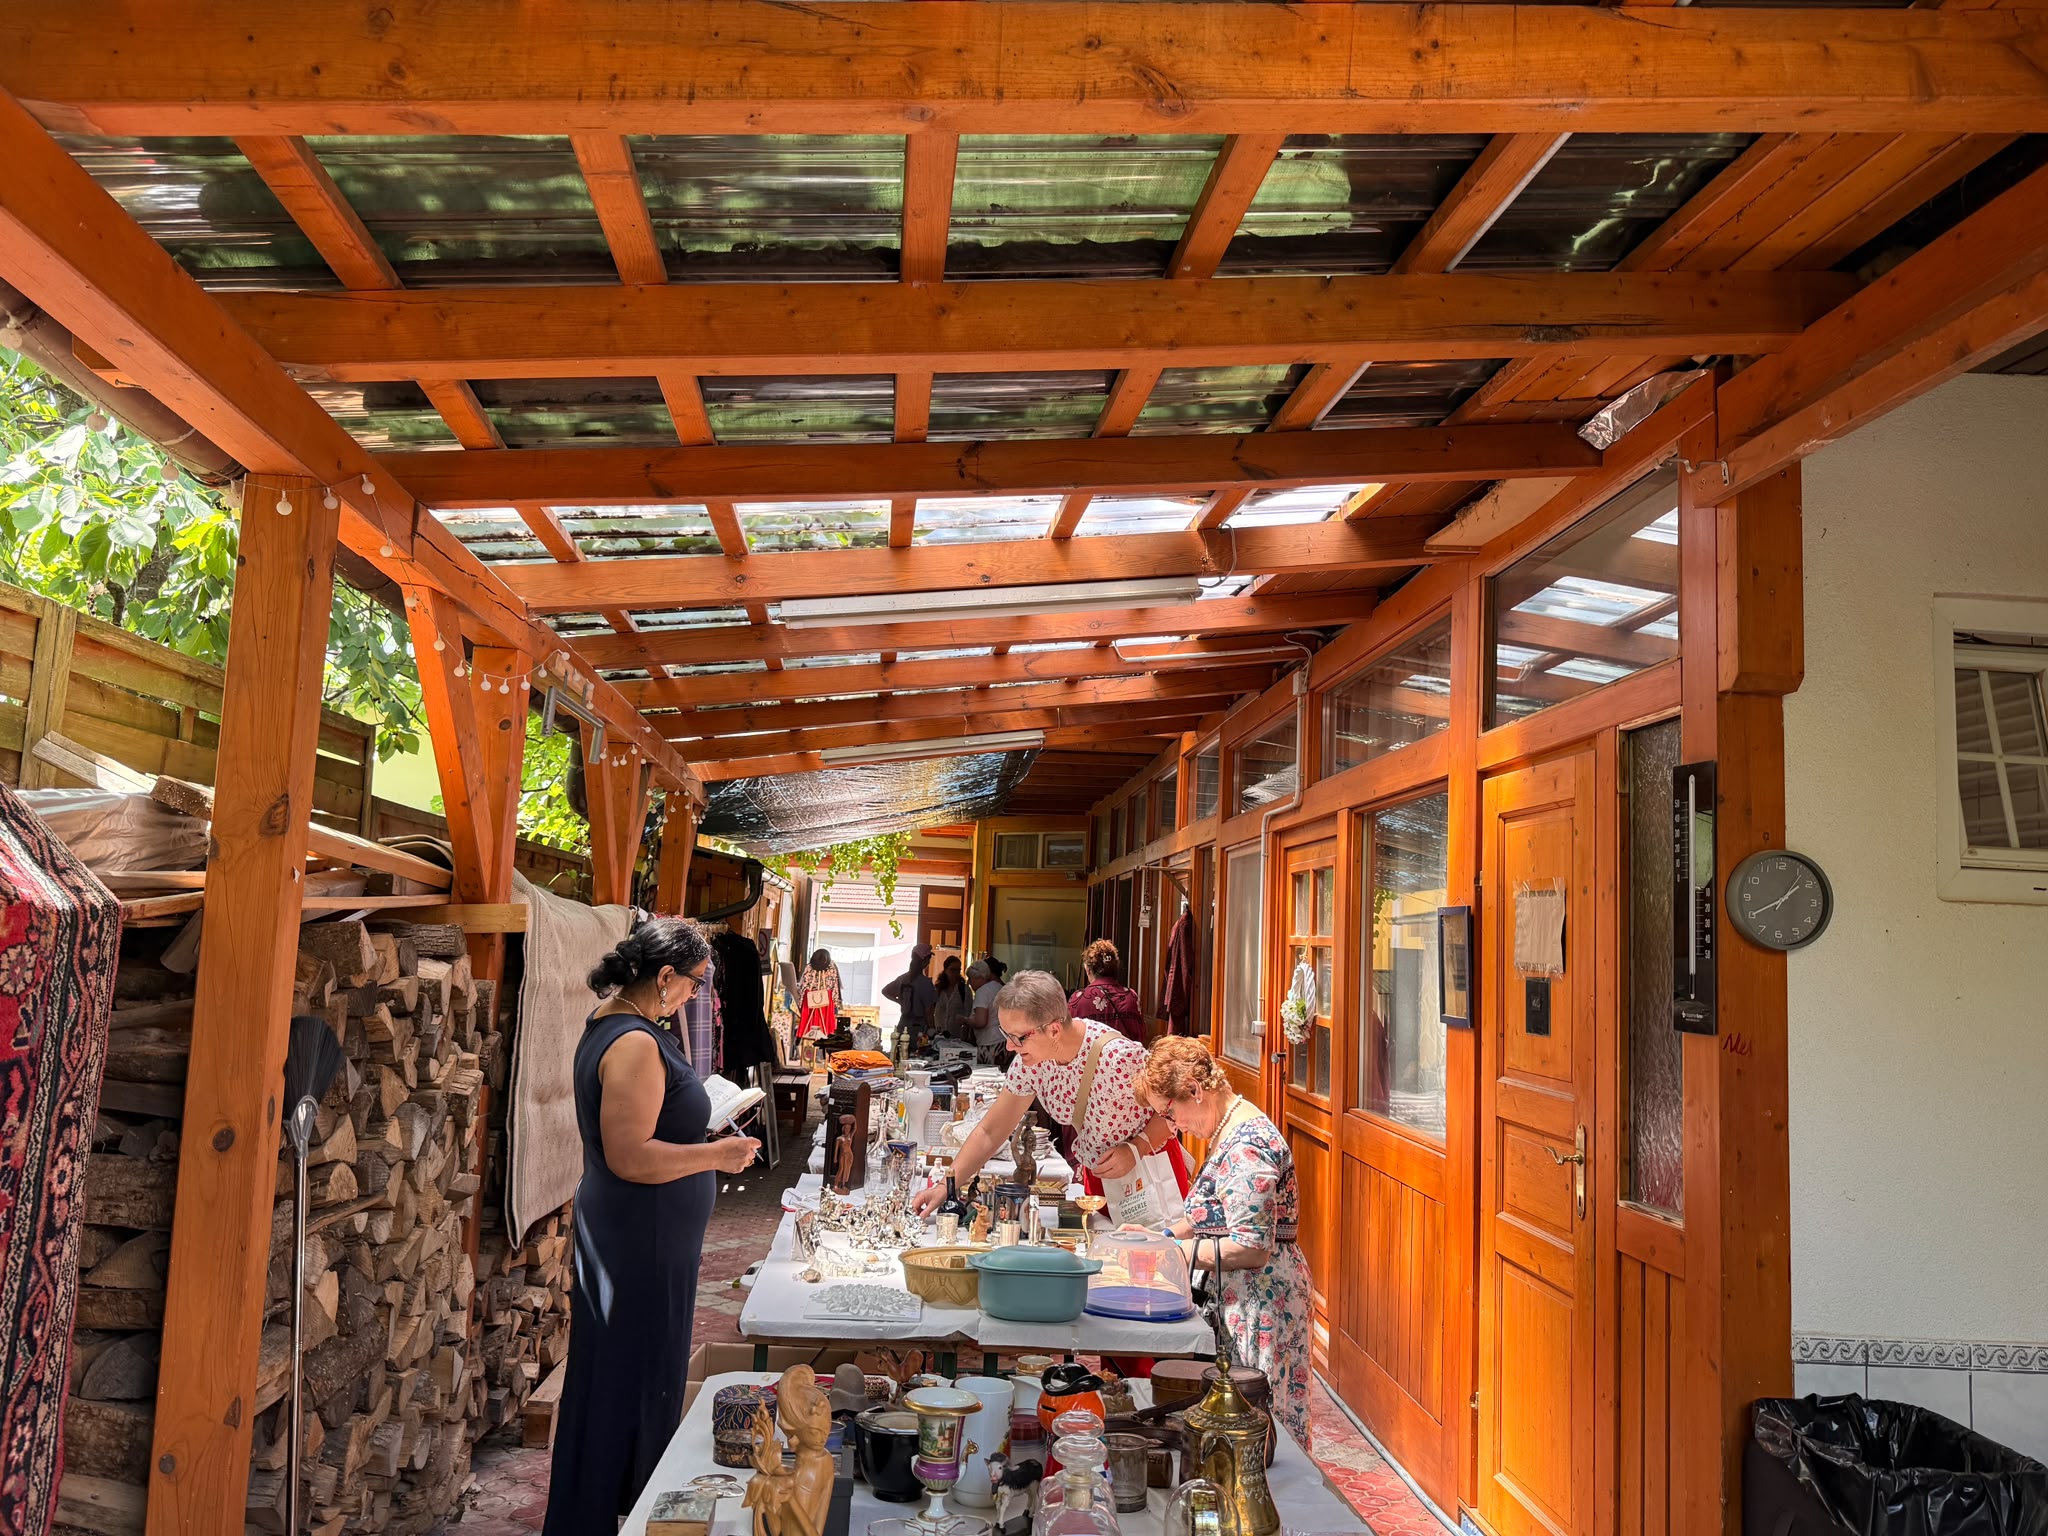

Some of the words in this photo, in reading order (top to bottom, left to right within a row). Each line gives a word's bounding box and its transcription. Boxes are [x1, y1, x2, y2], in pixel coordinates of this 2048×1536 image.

[1674, 799, 1680, 809] 50
[1761, 864, 1770, 873] 11
[1775, 861, 1787, 870] 12
[1748, 876, 1760, 885] 10
[1804, 880, 1813, 889] 2
[1705, 887, 1711, 897] 10
[1743, 893, 1752, 902] 9
[1810, 898, 1817, 907] 3
[1704, 903, 1711, 913] 20
[1704, 918, 1711, 928] 30
[1803, 916, 1812, 924] 4
[1758, 924, 1767, 935] 7
[1791, 927, 1800, 936] 5
[1704, 934, 1711, 944] 40
[1774, 930, 1783, 939] 6
[1704, 949, 1711, 959] 50
[1120, 1201, 1147, 1217] DROGERIE
